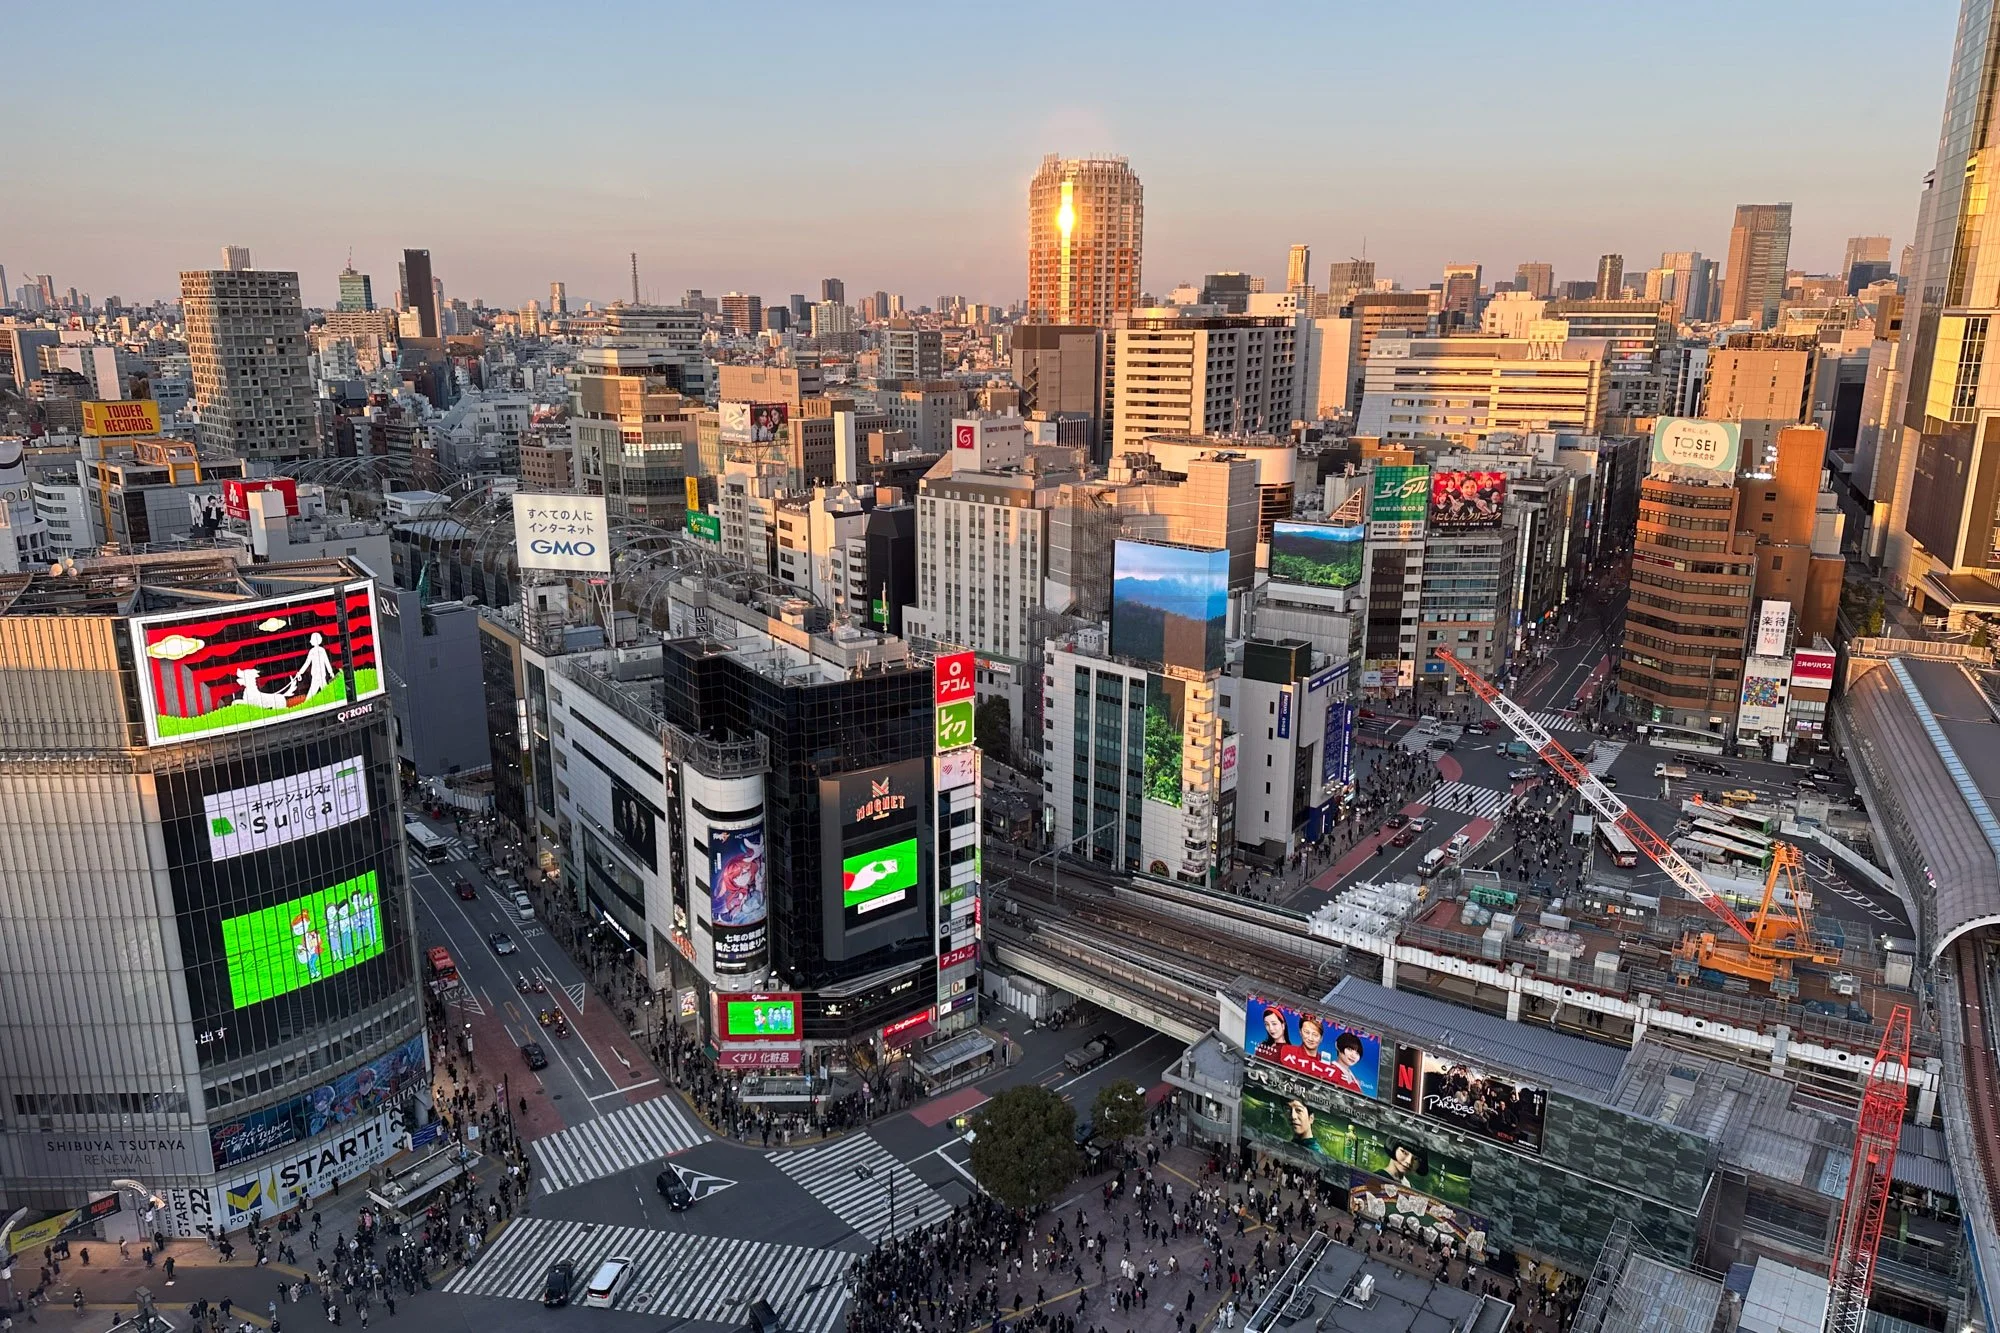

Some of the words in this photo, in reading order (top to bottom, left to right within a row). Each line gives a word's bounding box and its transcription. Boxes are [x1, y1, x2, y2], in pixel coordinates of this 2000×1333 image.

[105, 404, 144, 419] TOWER
[104, 417, 154, 433] RECORDS
[1674, 436, 1717, 452] TOSEI
[1374, 475, 1430, 499] エイブル
[527, 508, 593, 521] すべての人に
[1436, 512, 1502, 521] にしたんクリニック
[528, 522, 594, 534] インターネット
[530, 539, 596, 557] GMO
[1761, 616, 1786, 627] 楽待
[1796, 660, 1832, 669] 三井のリハウス
[940, 676, 970, 695] アコム
[337, 703, 373, 723] QFRONT
[941, 708, 954, 726] レ
[940, 719, 967, 741] イク
[251, 784, 332, 813] キャッシュレスは
[856, 795, 906, 823] MAGNET
[943, 886, 964, 901] レイク
[943, 951, 965, 966] アコム
[732, 1052, 757, 1063] くすり
[760, 1052, 789, 1063] 化粧品
[1283, 1053, 1336, 1078] ペイトク
[1247, 1067, 1269, 1085] JR
[1397, 1063, 1414, 1091] N
[376, 1078, 427, 1114] TSUTAYA
[1422, 1094, 1475, 1114] PARADES
[47, 1139, 112, 1152] SHIBUYA
[118, 1139, 186, 1151] TSUTAYA
[280, 1121, 382, 1188] START!
[188, 1188, 214, 1235] 4.22
